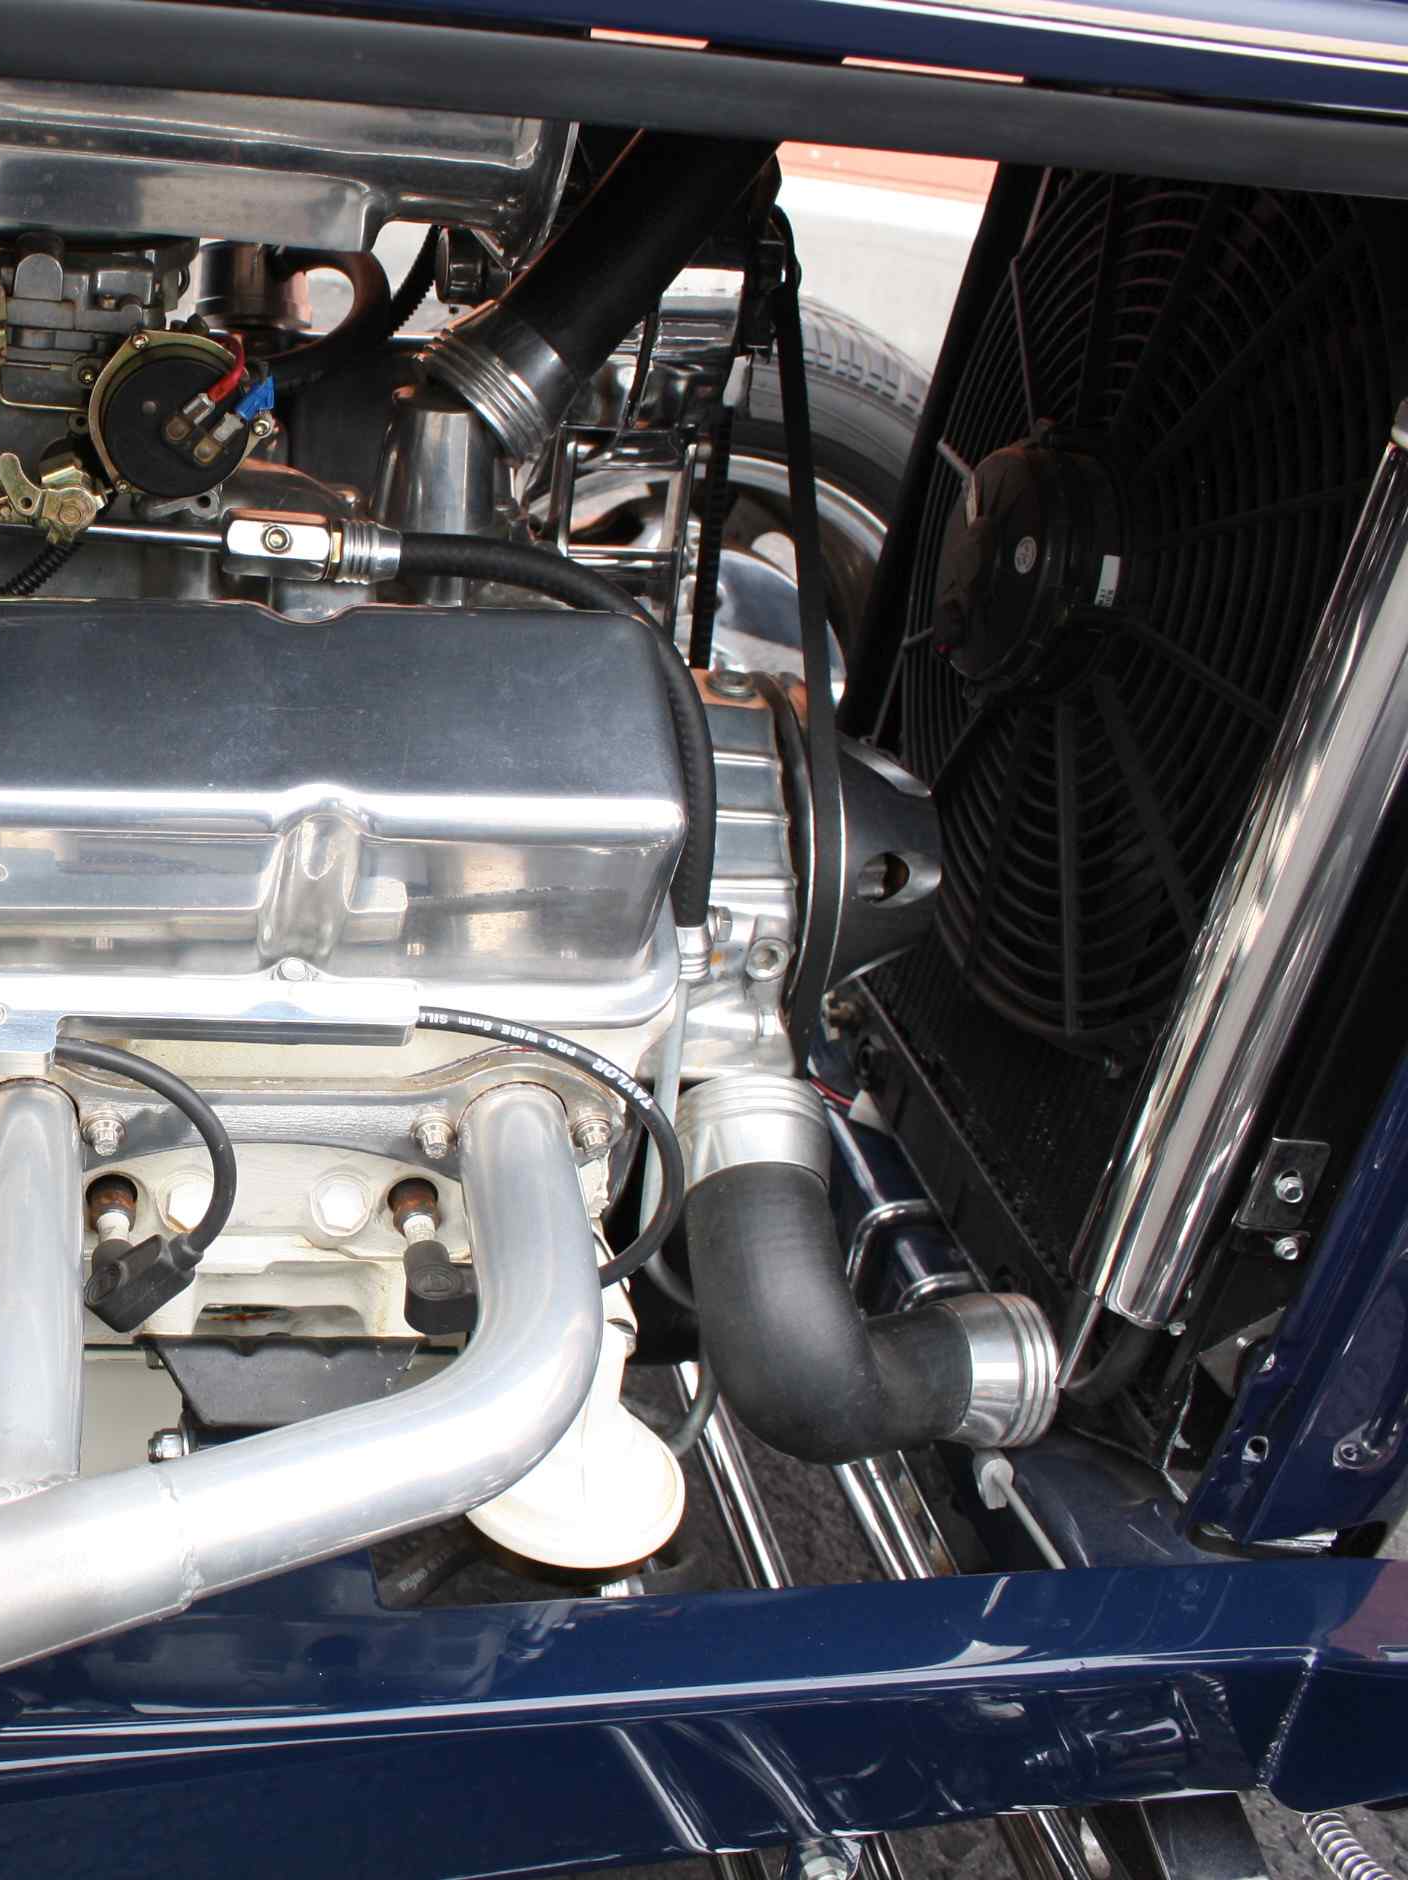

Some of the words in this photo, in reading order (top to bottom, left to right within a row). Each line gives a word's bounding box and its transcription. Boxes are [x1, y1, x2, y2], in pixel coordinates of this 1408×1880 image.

[458, 1015, 494, 1031] 8mm
[500, 1023, 539, 1043] WIRE
[546, 1037, 577, 1057] PRO
[592, 1058, 654, 1109] TAYLOR
